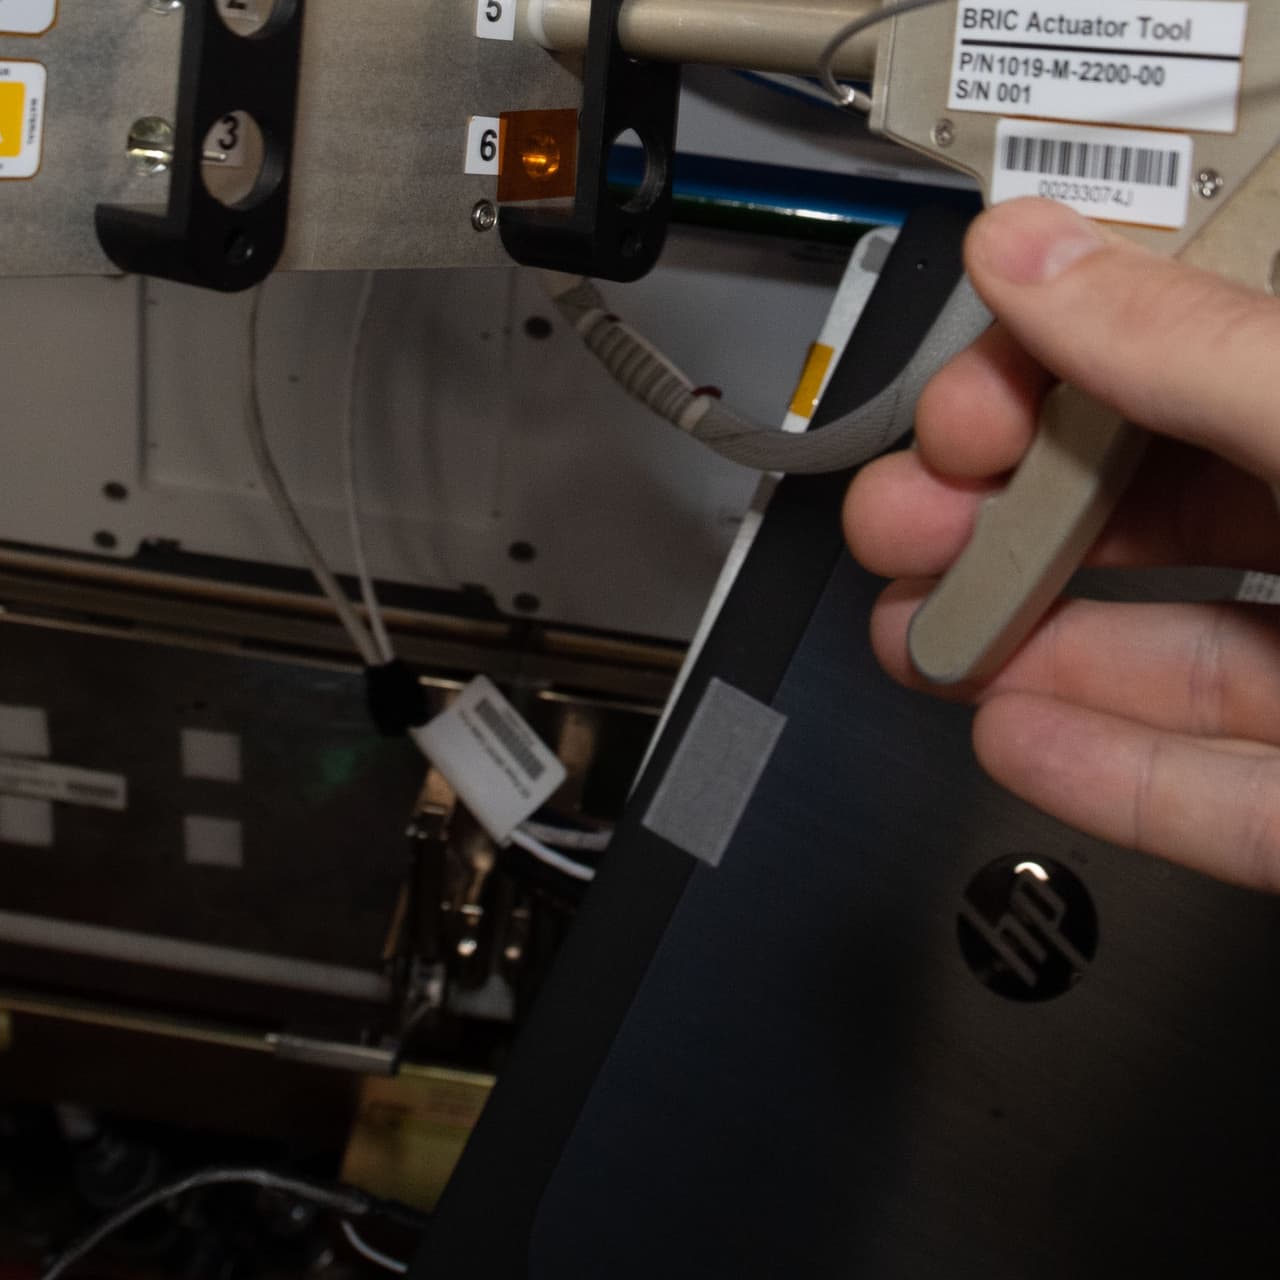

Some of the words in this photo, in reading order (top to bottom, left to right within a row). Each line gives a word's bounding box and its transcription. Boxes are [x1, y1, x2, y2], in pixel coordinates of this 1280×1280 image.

[963, 8, 1019, 32] BRIC
[1025, 11, 1129, 38] Actuator
[1137, 16, 1192, 41] Tool
[956, 79, 990, 101] S/N
[996, 83, 1031, 104] 001
[218, 114, 238, 151] 3
[480, 128, 497, 161] 6
